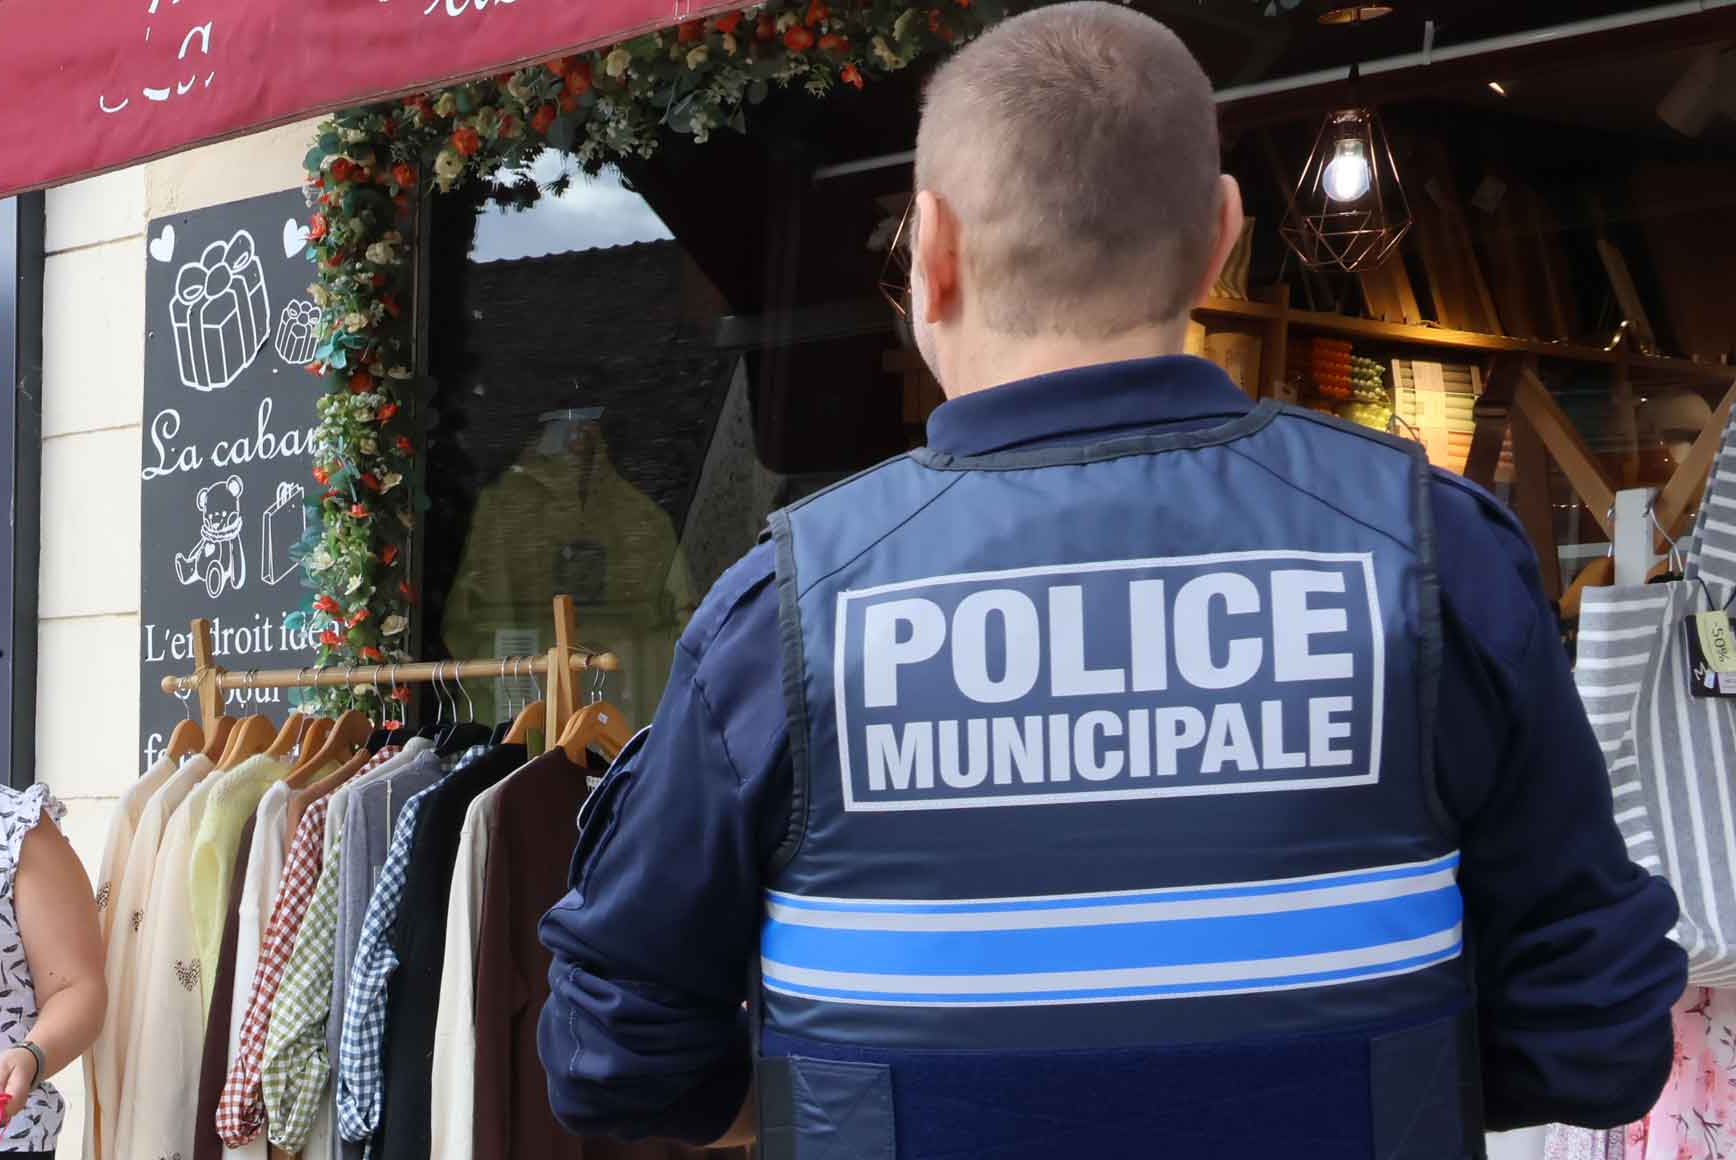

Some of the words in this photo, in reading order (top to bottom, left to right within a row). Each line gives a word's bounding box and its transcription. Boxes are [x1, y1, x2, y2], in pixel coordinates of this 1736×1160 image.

[142, 408, 203, 480] La
[864, 569, 1354, 708] POLICE
[865, 696, 1353, 791] MUNICIPALE
